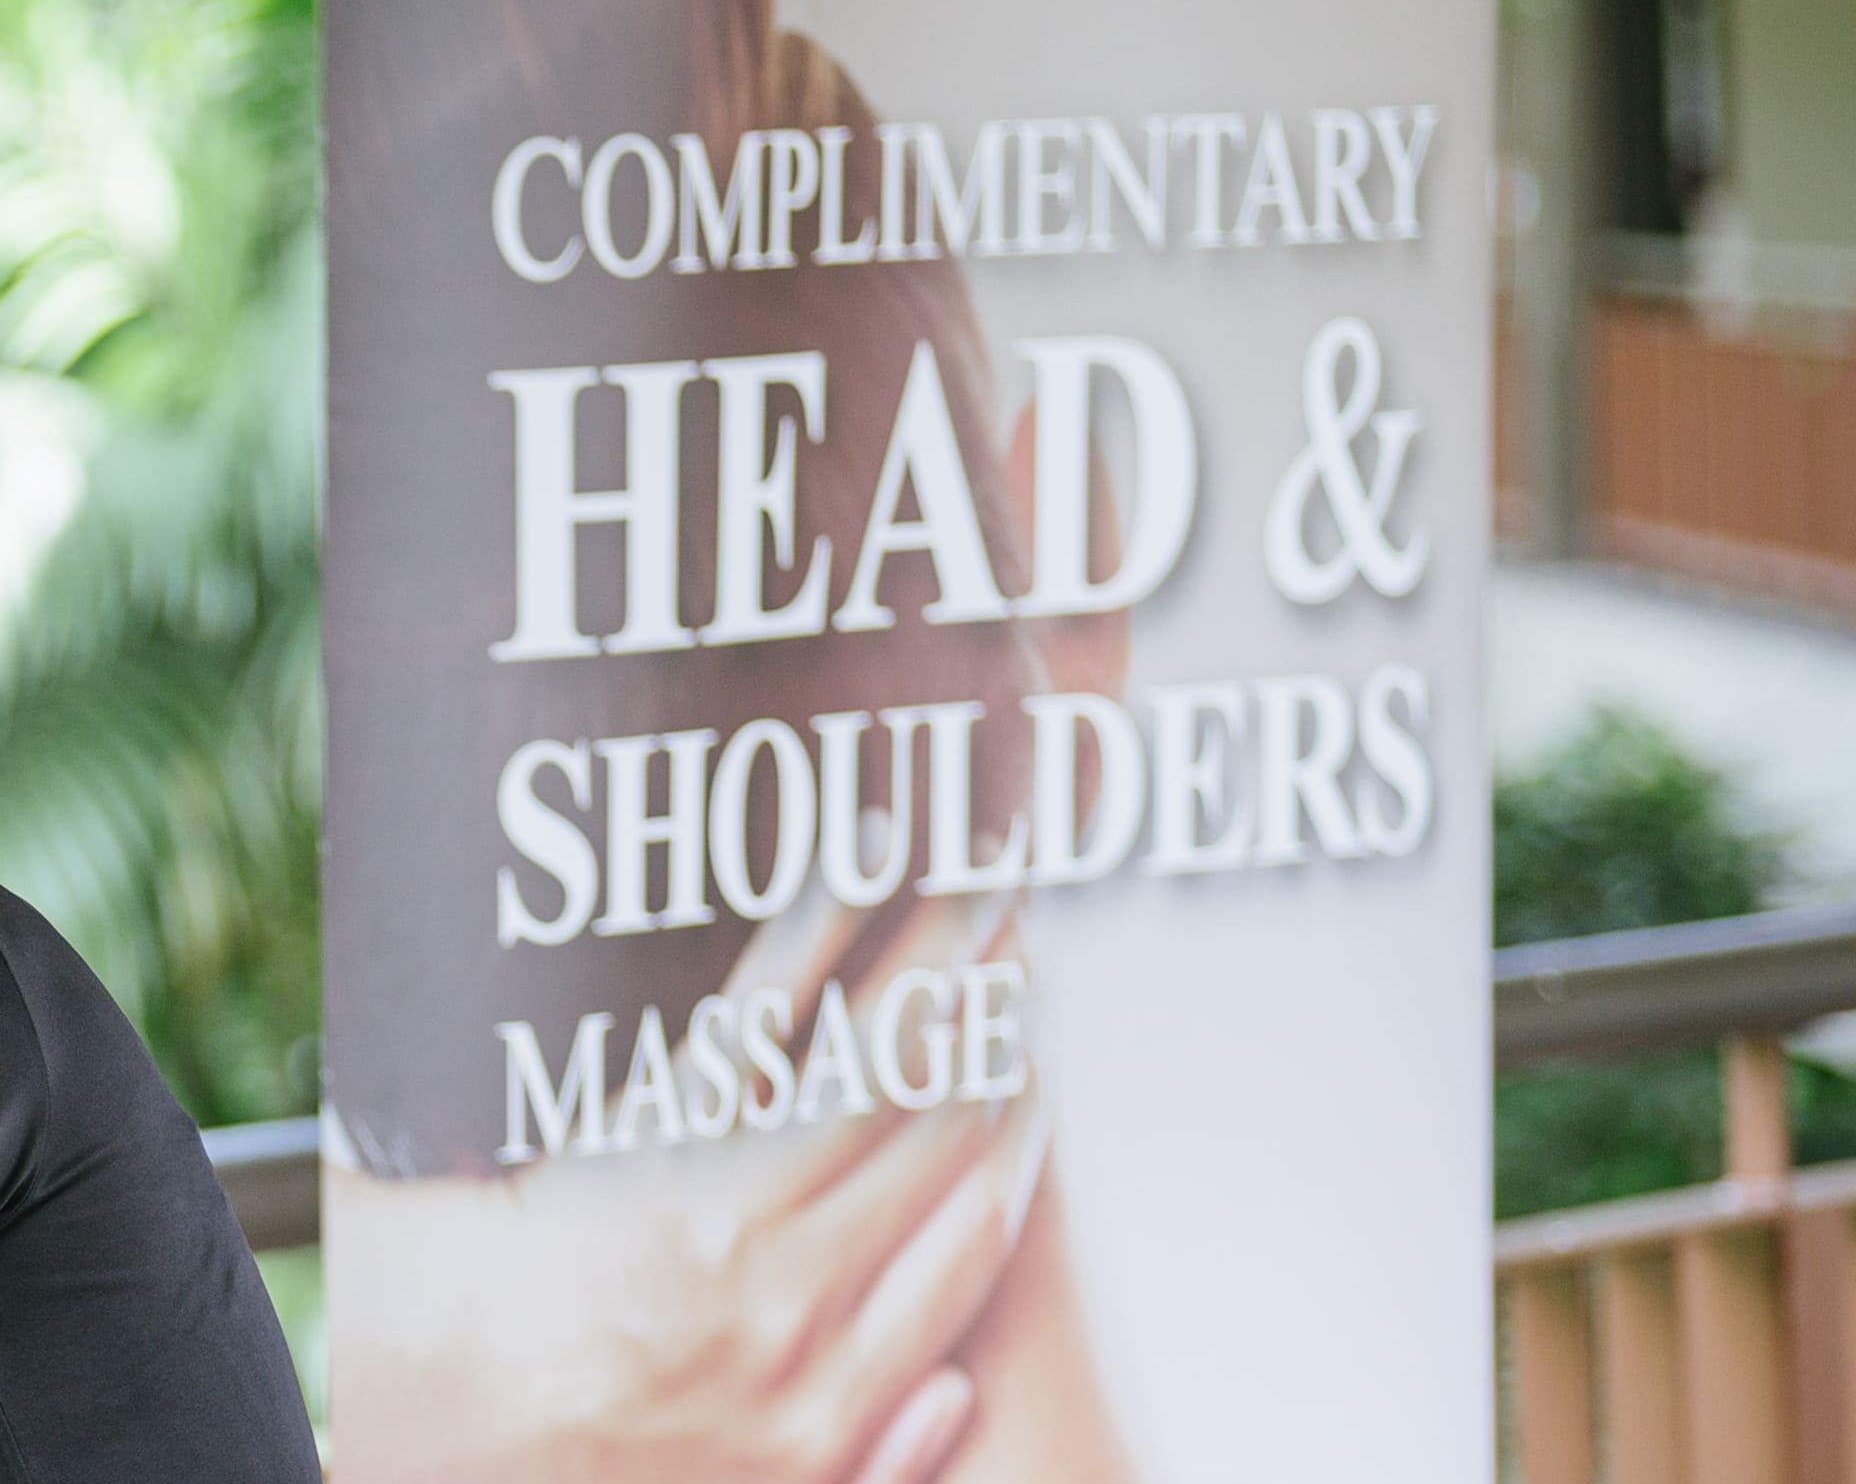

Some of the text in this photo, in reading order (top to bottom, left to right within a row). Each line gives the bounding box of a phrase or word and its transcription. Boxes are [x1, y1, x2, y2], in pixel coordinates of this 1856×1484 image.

[491, 104, 1440, 284] COMPLIMENTARY
[488, 316, 1431, 662] HEAD &
[496, 663, 1433, 947] SHOULDERS
[494, 962, 1027, 1165] MASSAGE
